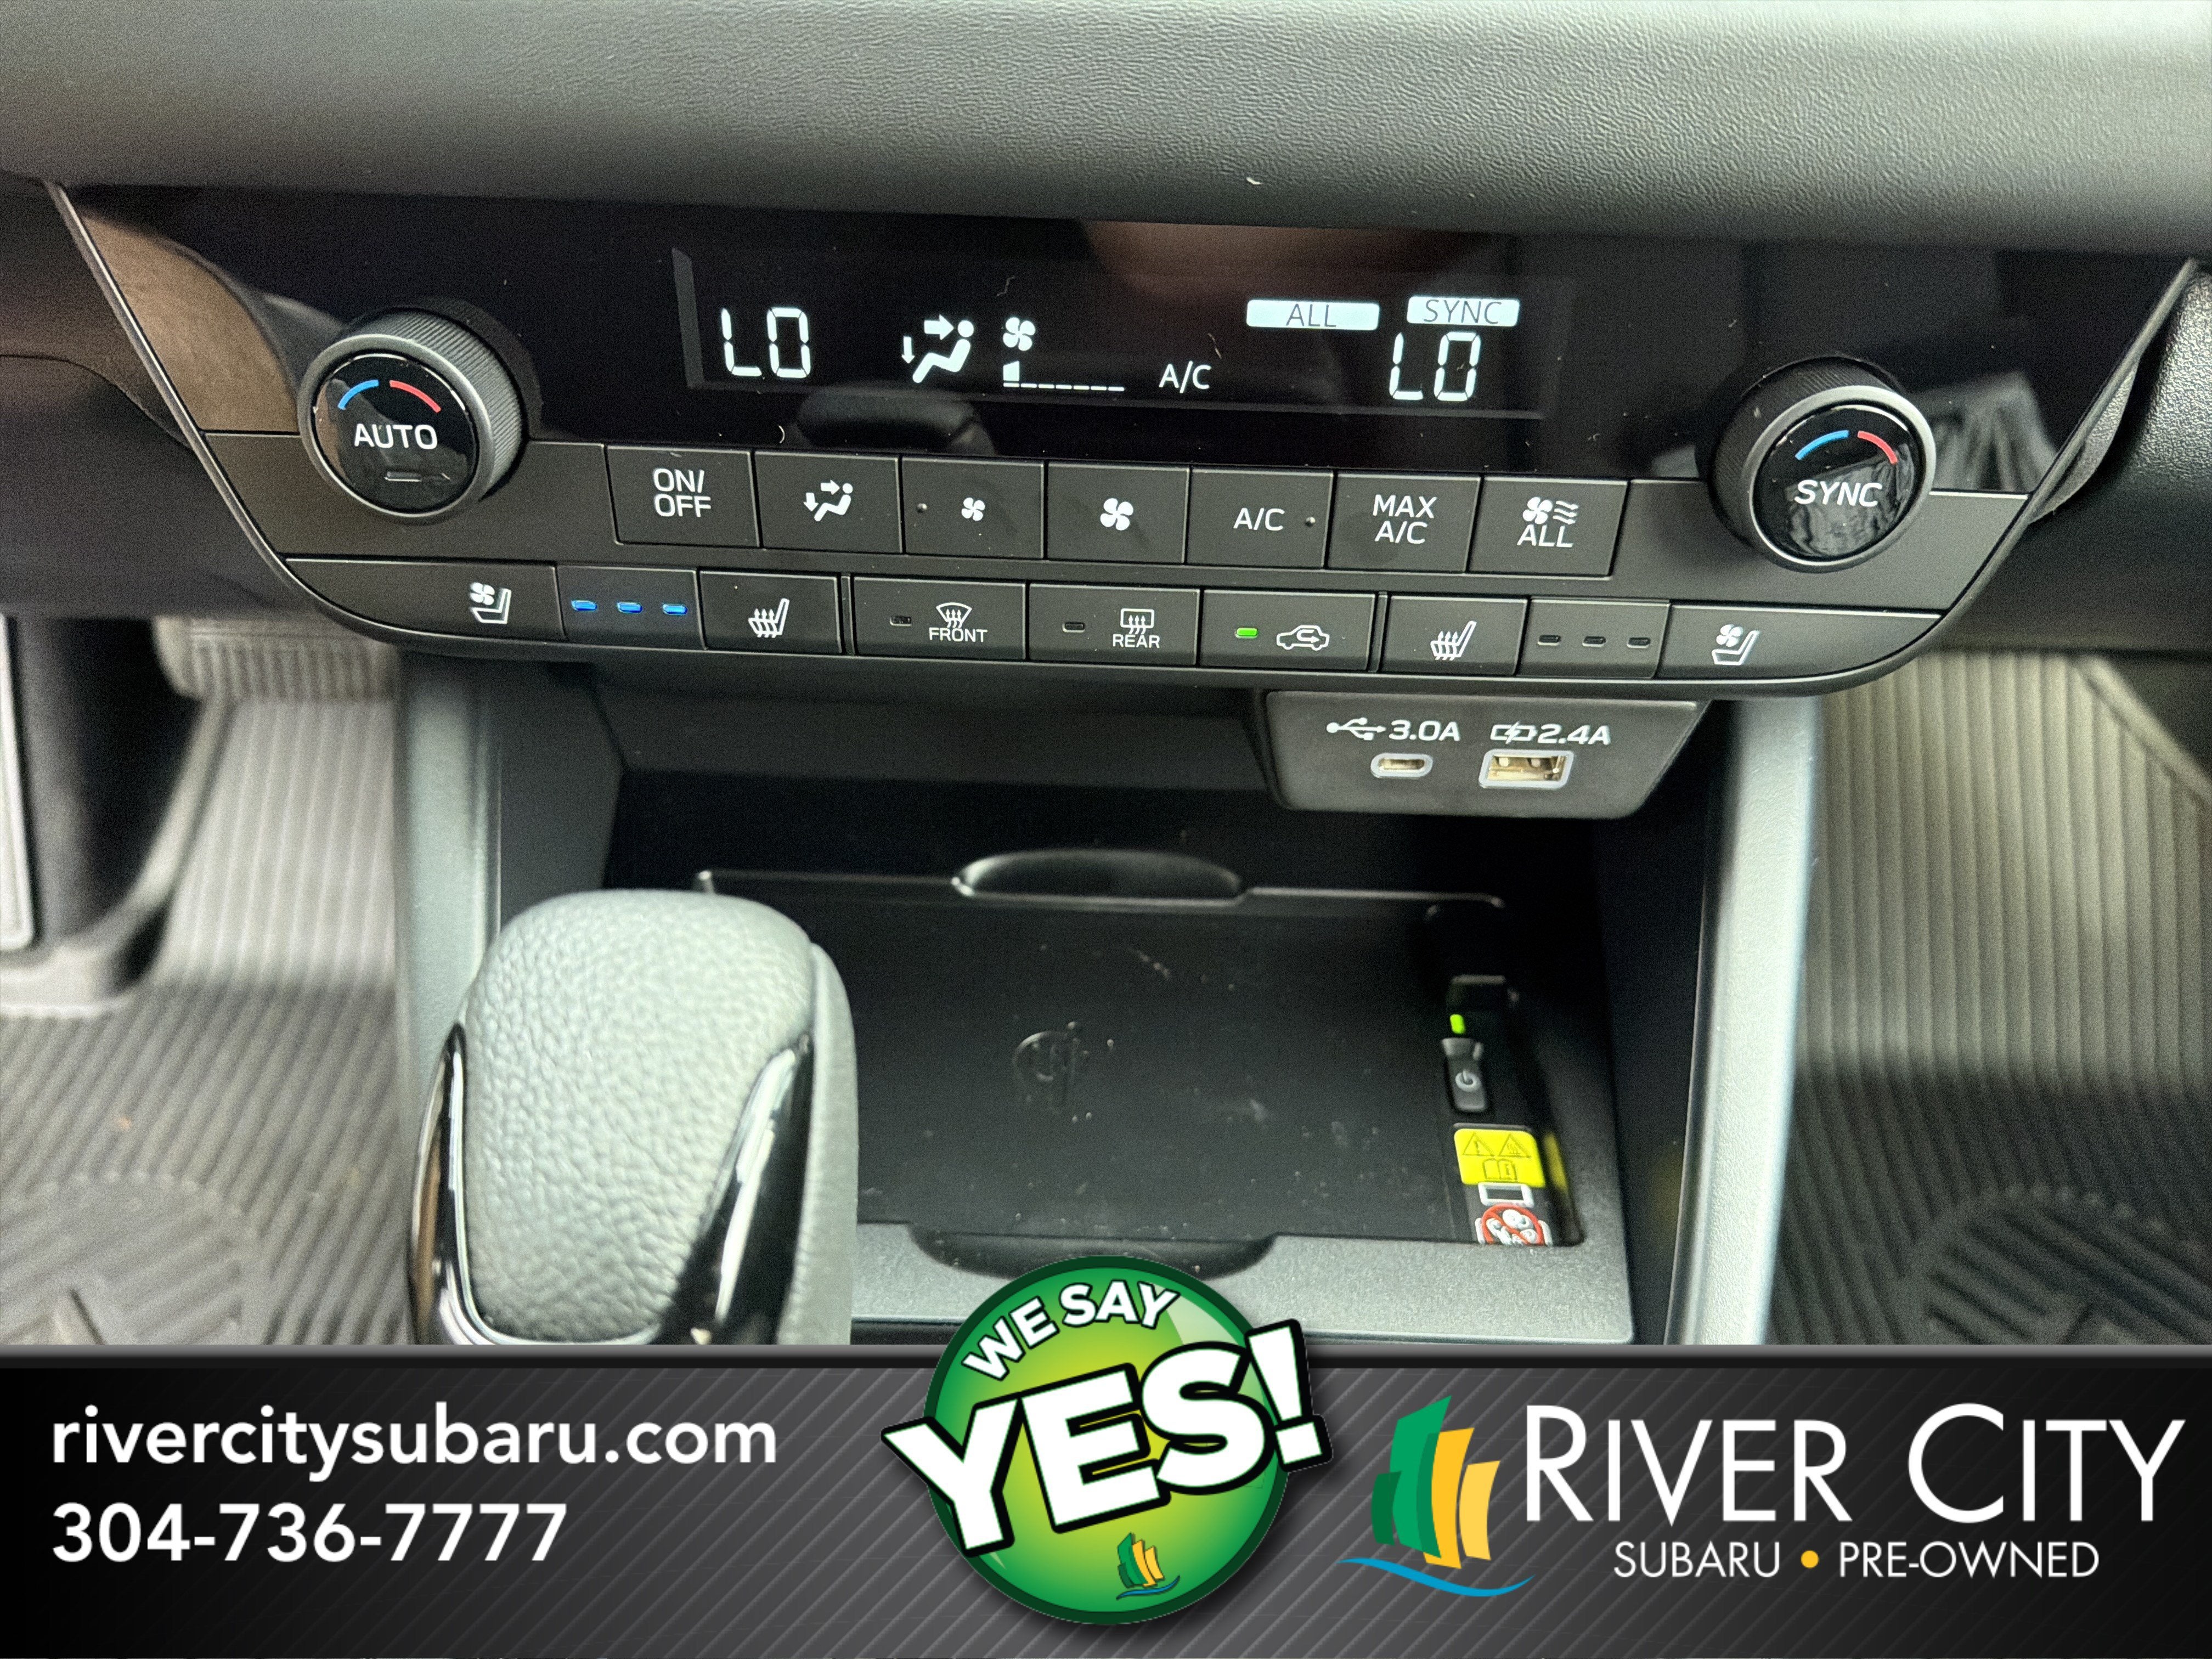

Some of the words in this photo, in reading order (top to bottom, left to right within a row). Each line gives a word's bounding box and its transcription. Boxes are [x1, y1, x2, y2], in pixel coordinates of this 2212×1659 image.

[1285, 303, 1338, 328] ALL
[1423, 298, 1504, 325] SYNC
[1158, 360, 1212, 394] A/C
[354, 422, 438, 450] AUTO
[652, 468, 705, 493] ON/
[653, 493, 712, 518] OFF
[1372, 493, 1438, 519] MAX
[1793, 479, 1883, 508] SYNC
[1233, 507, 1285, 532] A/C
[1374, 520, 1429, 545] A/C
[1516, 524, 1575, 549] ALL
[928, 627, 988, 643] FRONT
[1112, 634, 1161, 649] REAR
[1388, 719, 1461, 742] 3.0A
[1537, 723, 1612, 746] 2.4A
